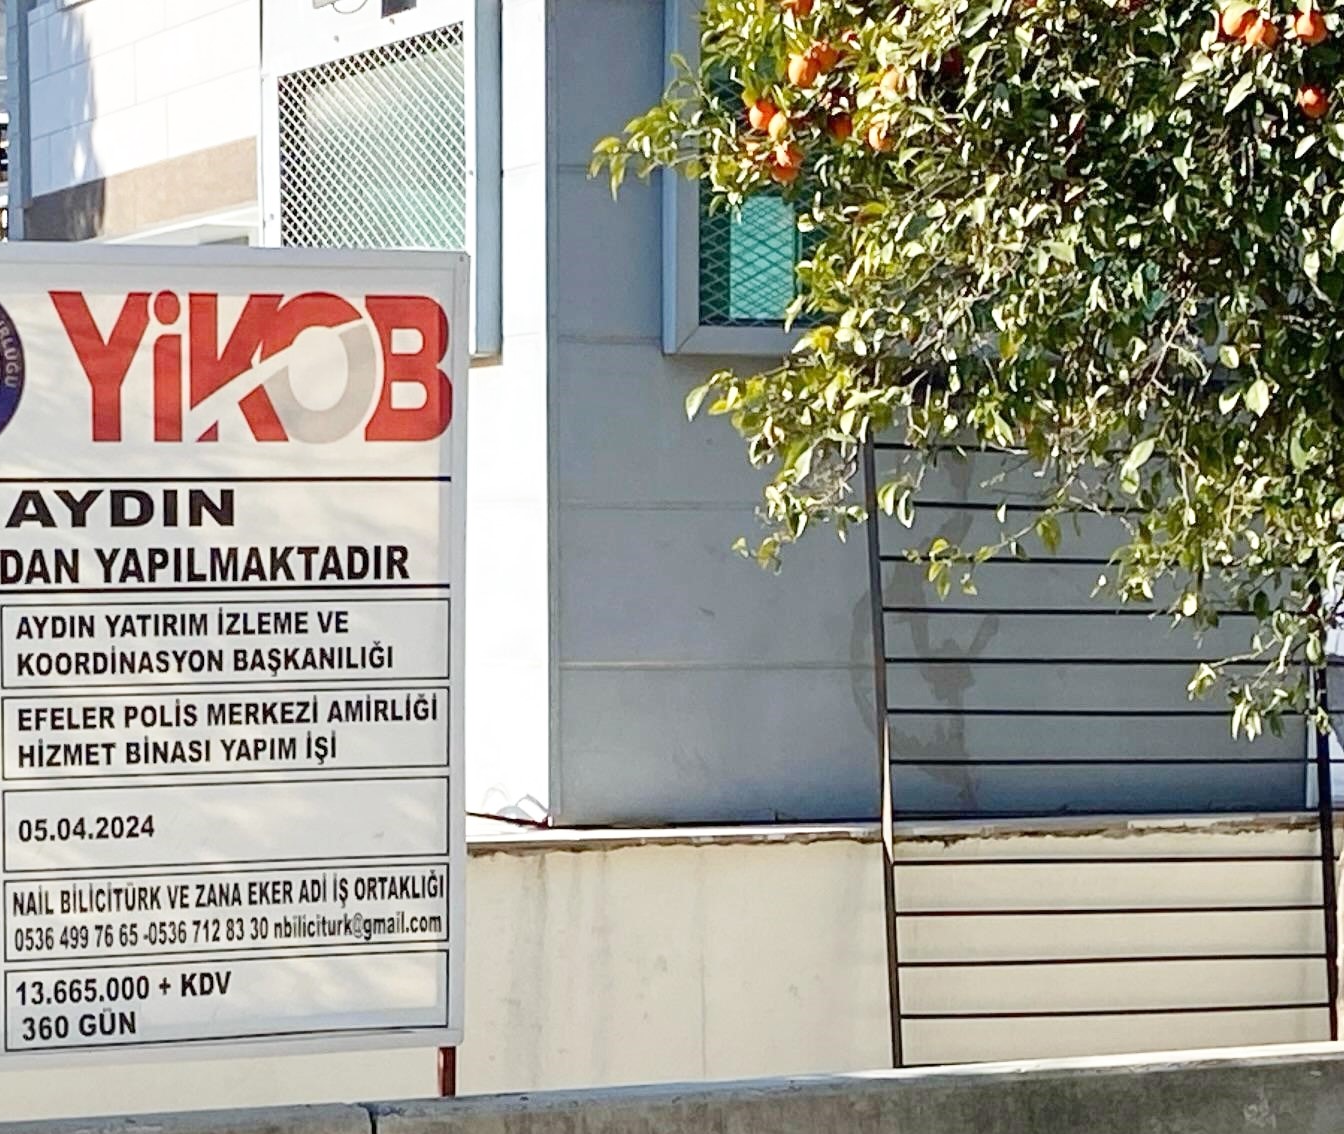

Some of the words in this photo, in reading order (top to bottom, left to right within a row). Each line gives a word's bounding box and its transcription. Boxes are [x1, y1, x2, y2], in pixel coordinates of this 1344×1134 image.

[5, 489, 234, 528] AYDIN
[94, 545, 410, 583] YAPILMAKTADIR
[16, 615, 95, 639] AYDIN
[105, 613, 208, 638] YATIRIM
[218, 607, 308, 635] İZLEME
[317, 611, 348, 633] VE
[17, 646, 223, 676] KOORDİNASYON
[233, 641, 393, 677] BAŞKANILIĞI
[18, 706, 115, 731] EFELER
[124, 699, 198, 728] POLİS
[207, 695, 318, 725] MERKEZİ
[327, 693, 437, 722] AMİRLİĞİ
[18, 739, 116, 769] HİZMET
[126, 736, 210, 764] BİNASI
[221, 738, 296, 761] YAPIM
[306, 730, 336, 765] İŞİ
[19, 815, 154, 842] 05.04.2024
[13, 885, 54, 916] NAİL
[167, 885, 189, 909] VE
[195, 882, 242, 908] ZANA
[248, 880, 293, 905] EKER
[299, 872, 327, 903] ADİ
[333, 872, 348, 908] İŞ
[355, 870, 444, 900] ORTAKLIĞI
[15, 927, 54, 951] 0536
[60, 925, 89, 949] 499
[95, 924, 113, 947] 76
[119, 923, 138, 946] 65
[193, 918, 220, 943] 712
[226, 917, 244, 941] 83
[250, 916, 268, 939] 30
[16, 975, 149, 1006] 13.665.000
[159, 977, 171, 996] +
[181, 971, 231, 997] KDV
[23, 1013, 69, 1041] 360
[79, 1007, 136, 1037] GÜN
